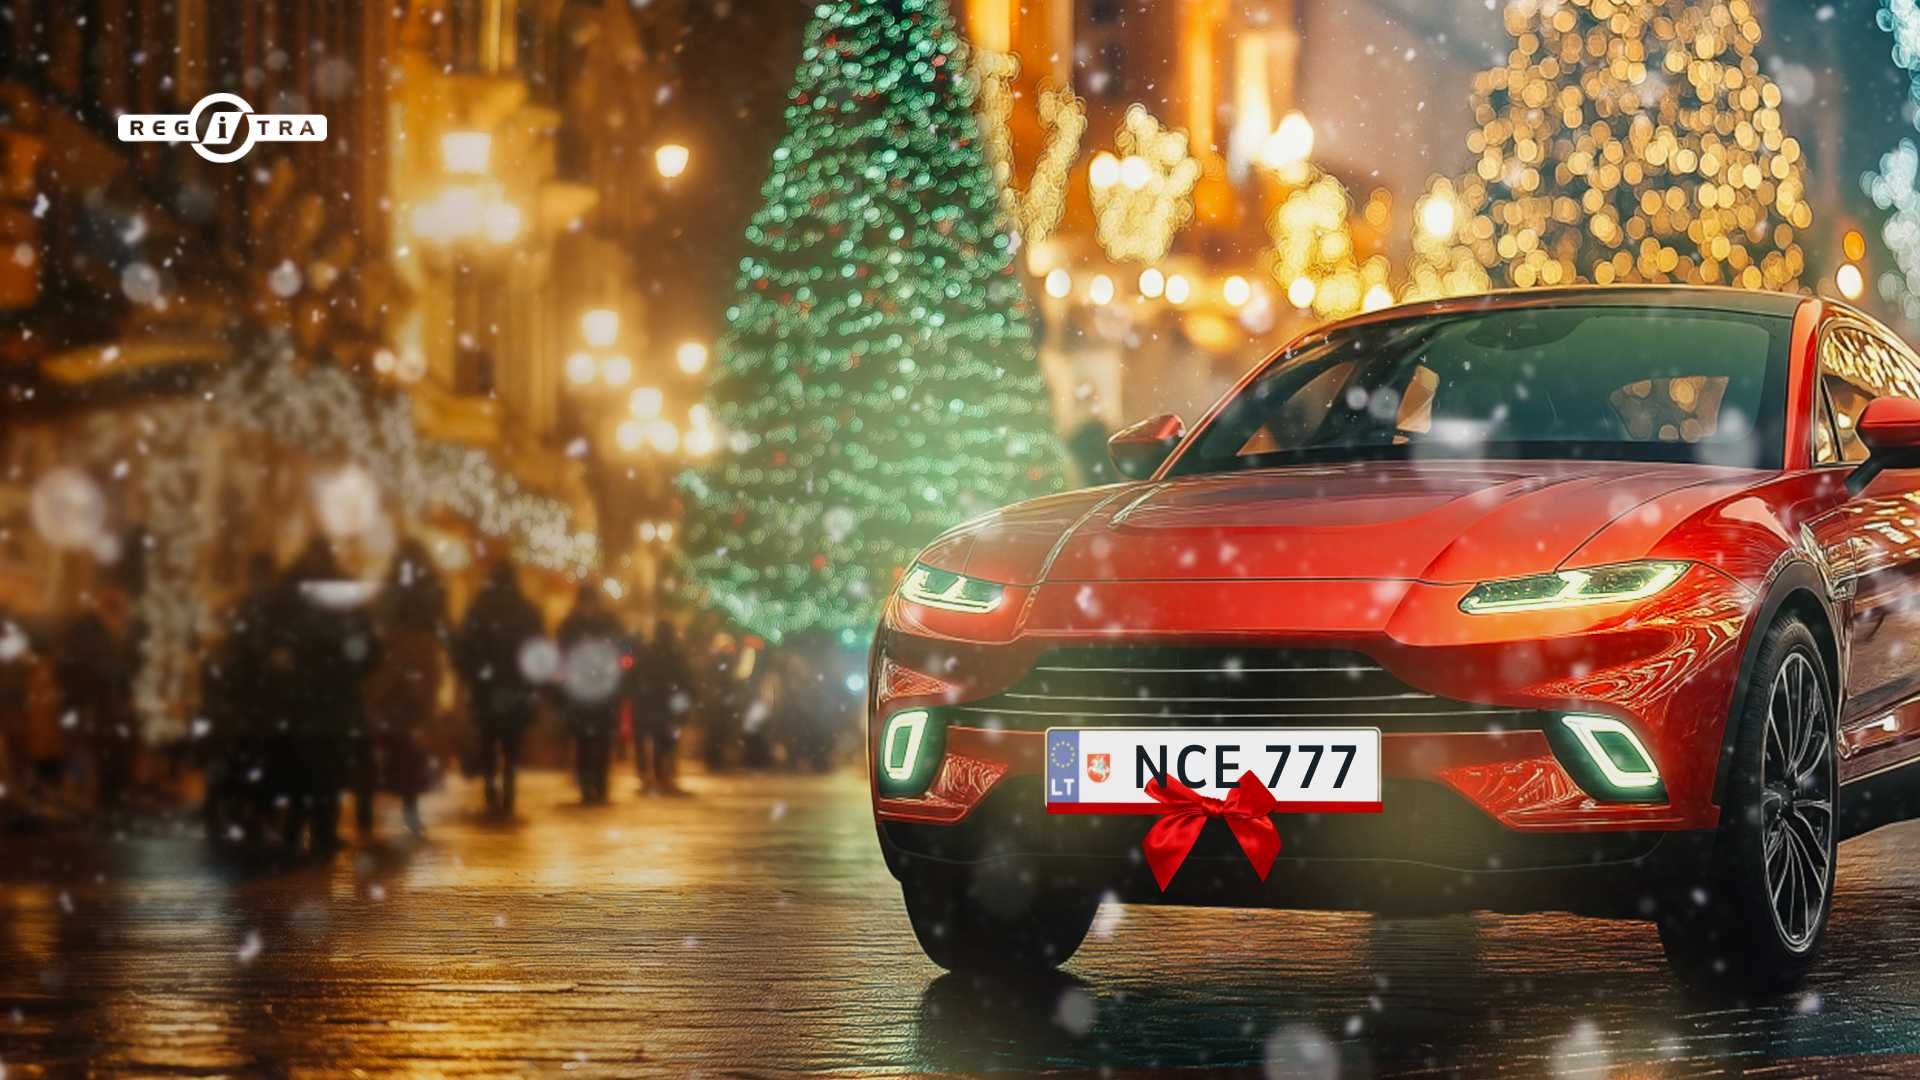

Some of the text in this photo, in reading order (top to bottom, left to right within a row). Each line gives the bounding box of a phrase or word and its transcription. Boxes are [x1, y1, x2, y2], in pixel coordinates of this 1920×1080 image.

[1135, 744, 1357, 789] NCE 777
[1051, 778, 1075, 796] LT
